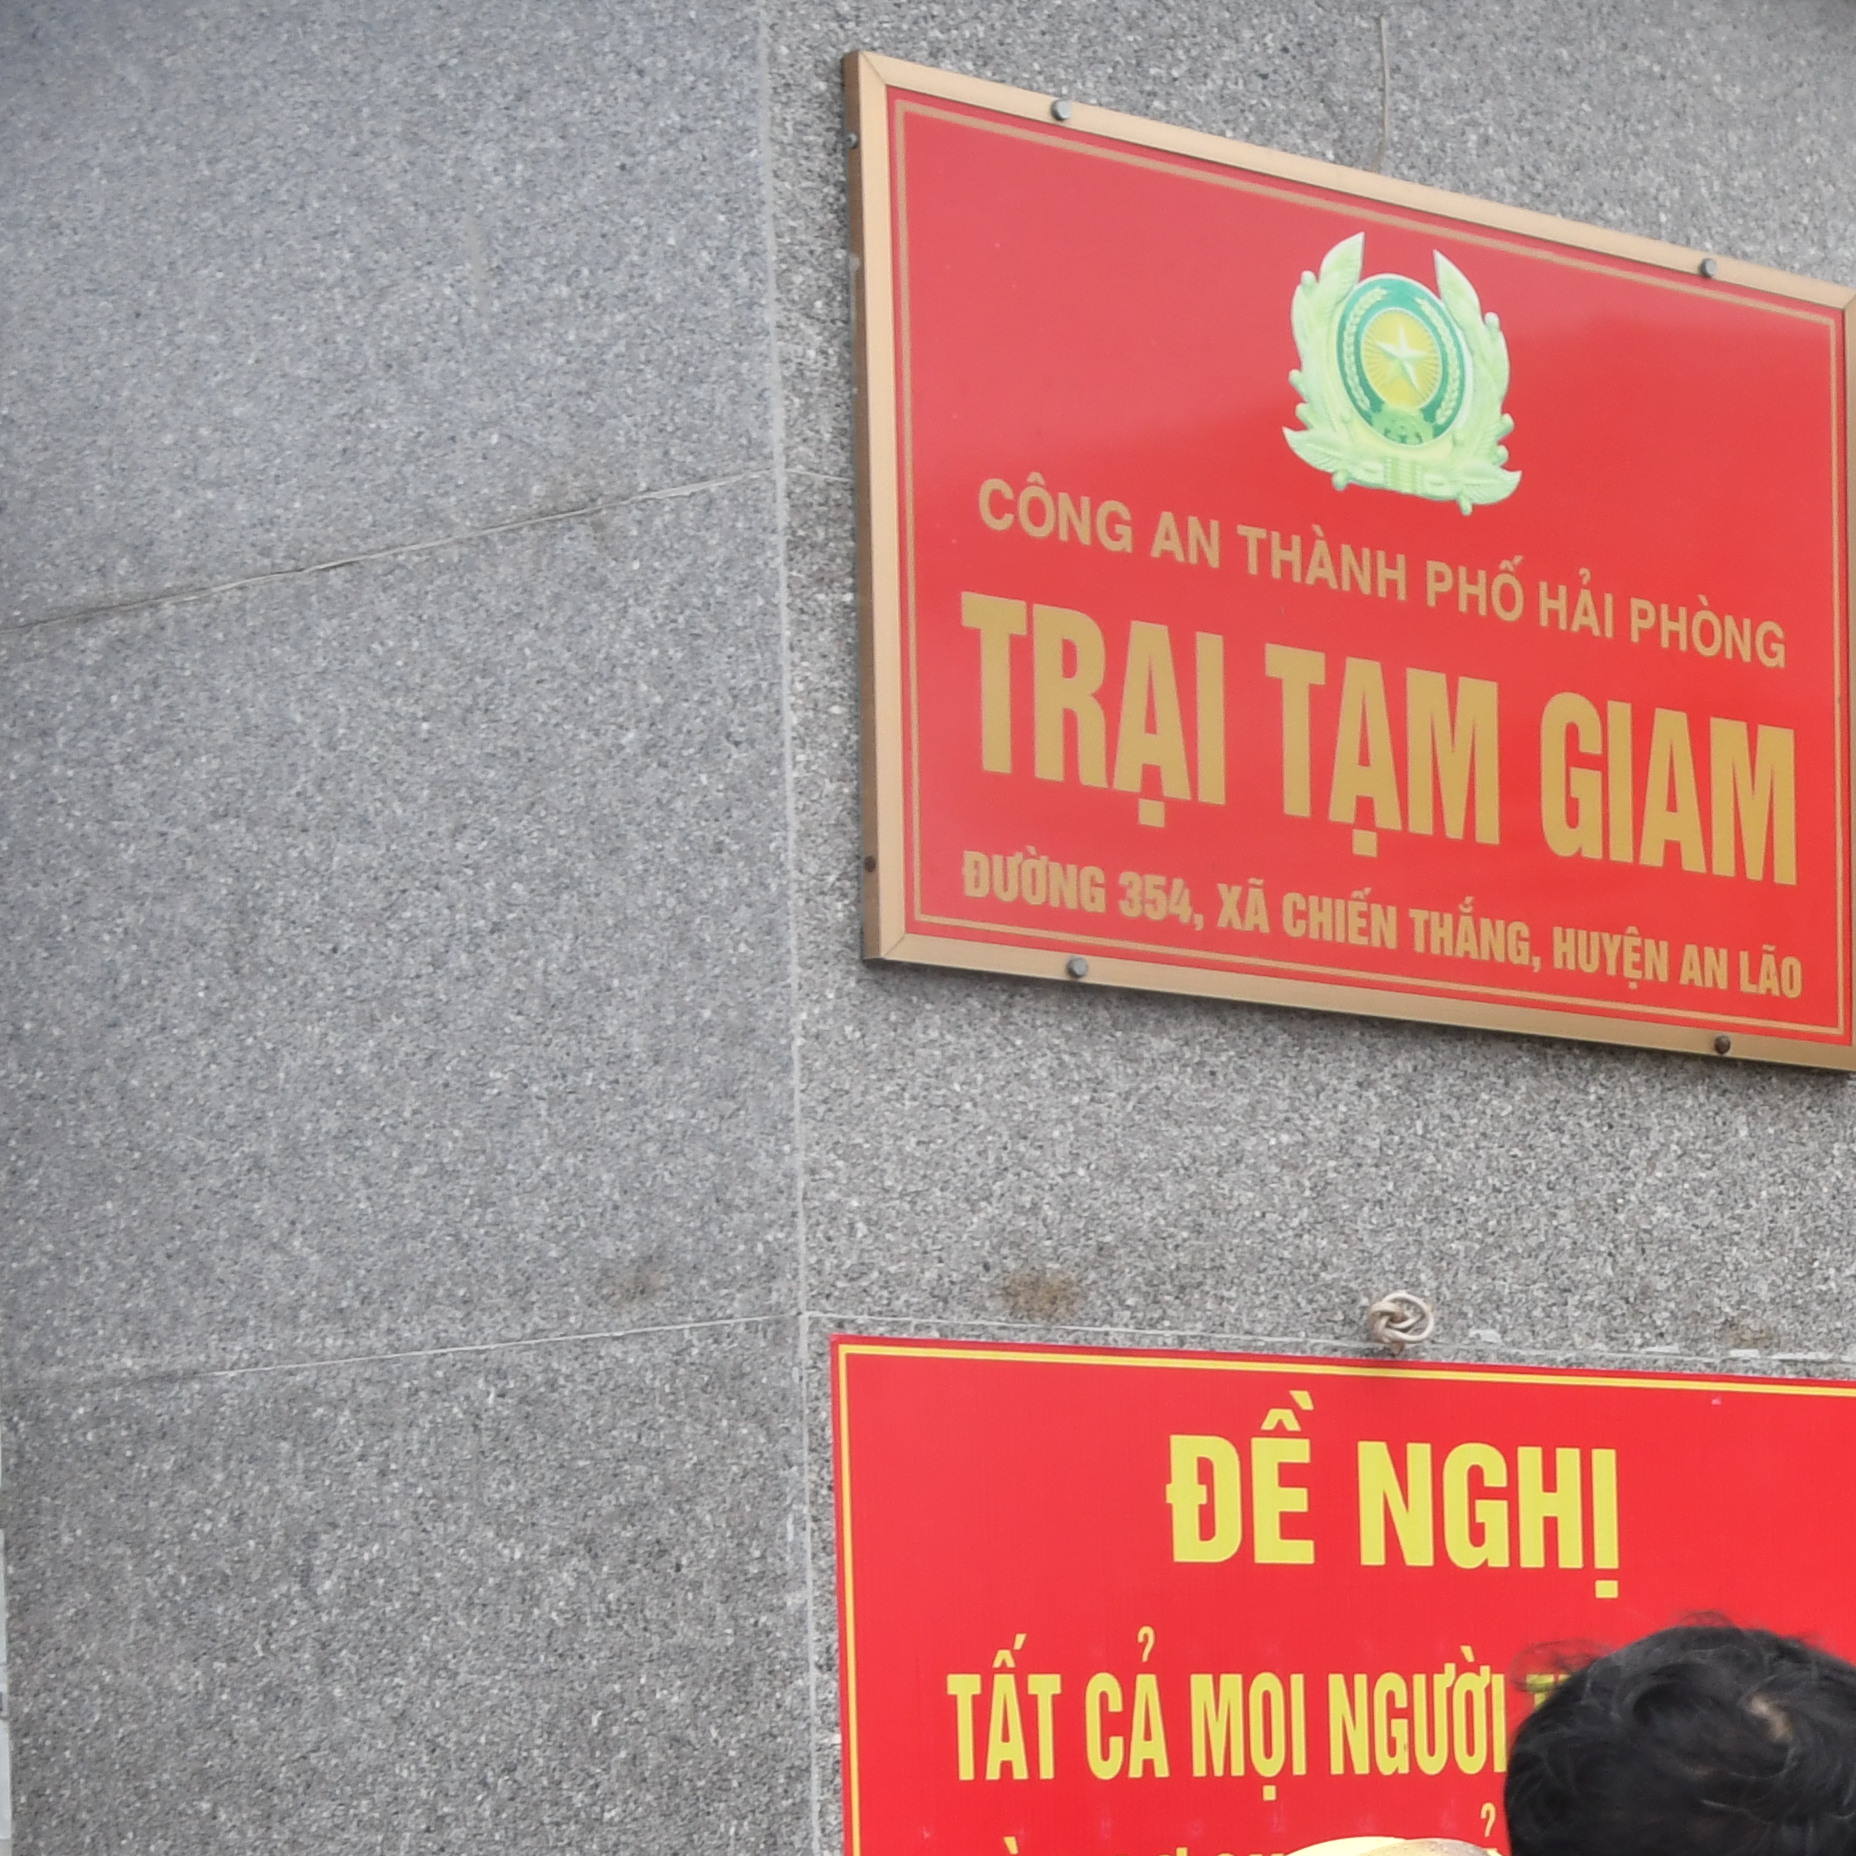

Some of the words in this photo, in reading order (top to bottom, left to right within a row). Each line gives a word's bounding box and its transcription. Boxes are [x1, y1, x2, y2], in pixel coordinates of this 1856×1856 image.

[978, 472, 1133, 553] CÔNG
[1150, 511, 1220, 569] AN
[1237, 525, 1407, 601] THÀNH
[1426, 555, 1524, 623] PHỐ
[1538, 568, 1614, 638] HẢI
[1630, 594, 1787, 669] PHÒNG
[961, 591, 1226, 828] TRẠI
[1264, 642, 1500, 857] TẠM
[1540, 691, 1797, 886] GIAM
[961, 847, 1107, 914] ĐƯỜNG
[1118, 871, 1204, 932] 354,
[1216, 877, 1271, 934] XÃ
[1281, 888, 1398, 950] CHIẾN
[1409, 903, 1542, 974] THẮNG,
[1552, 925, 1670, 992] HUYỆN
[1679, 943, 1729, 989] AN
[1739, 943, 1803, 998] LÃO
[1166, 1390, 1315, 1565] ĐỀ
[1360, 1440, 1620, 1599] NGHỊ
[946, 1633, 1062, 1782] TẤT
[1085, 1626, 1170, 1780] CẢ
[1192, 1671, 1306, 1801] MỌI
[1328, 1645, 1507, 1776] NGƯỜI
